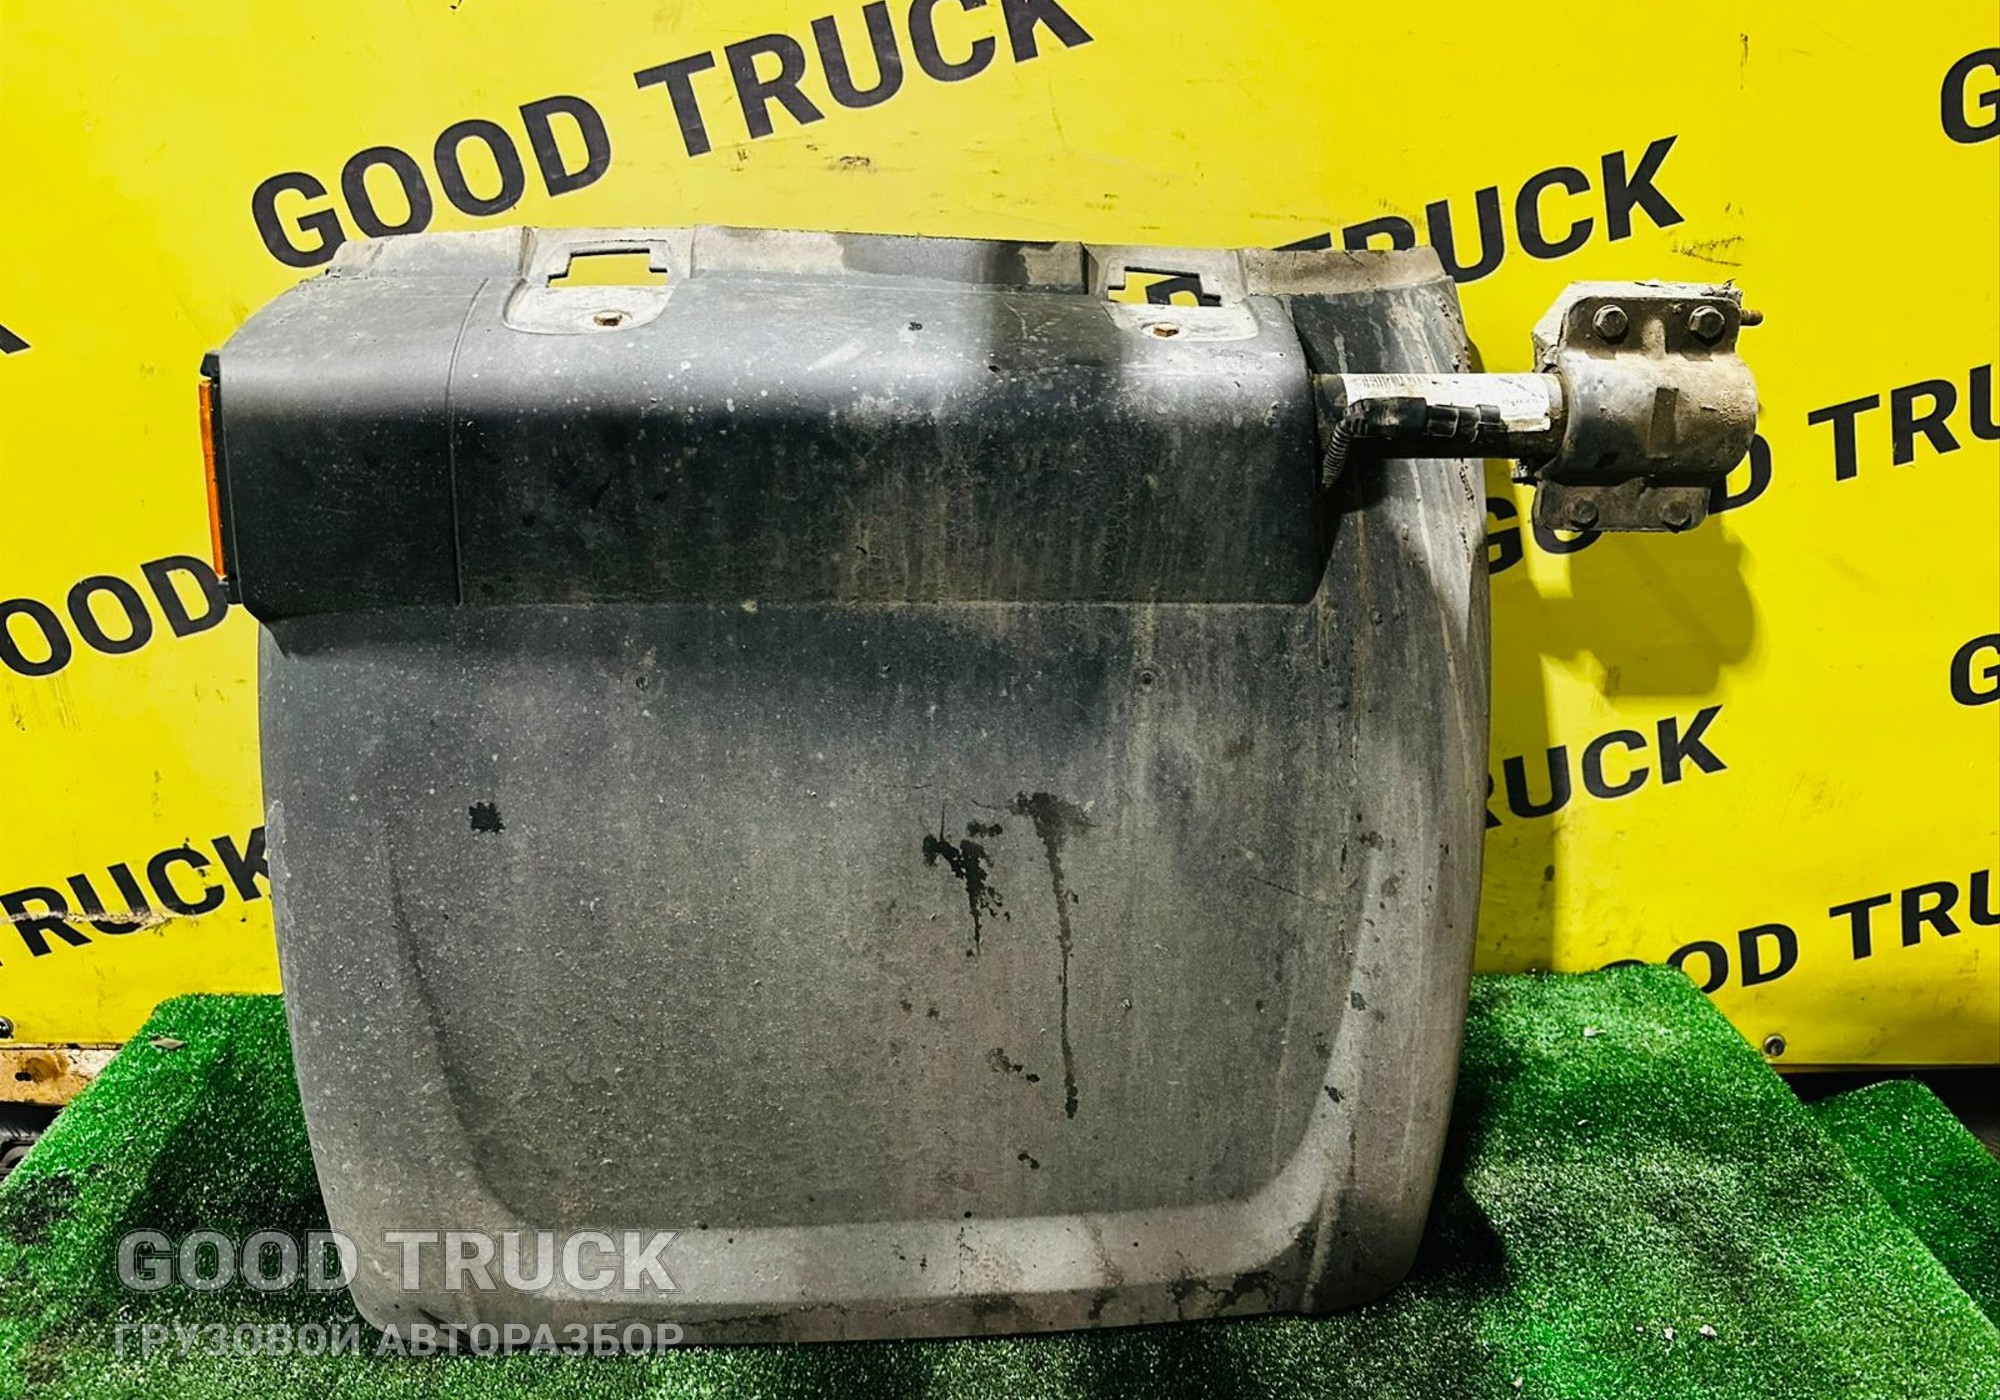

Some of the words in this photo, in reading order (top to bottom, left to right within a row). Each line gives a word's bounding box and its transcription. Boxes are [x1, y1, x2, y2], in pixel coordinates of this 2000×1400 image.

[252, 95, 611, 268] GOOD
[634, 0, 1094, 157] TRUCK
[0, 826, 272, 965] RUCK
